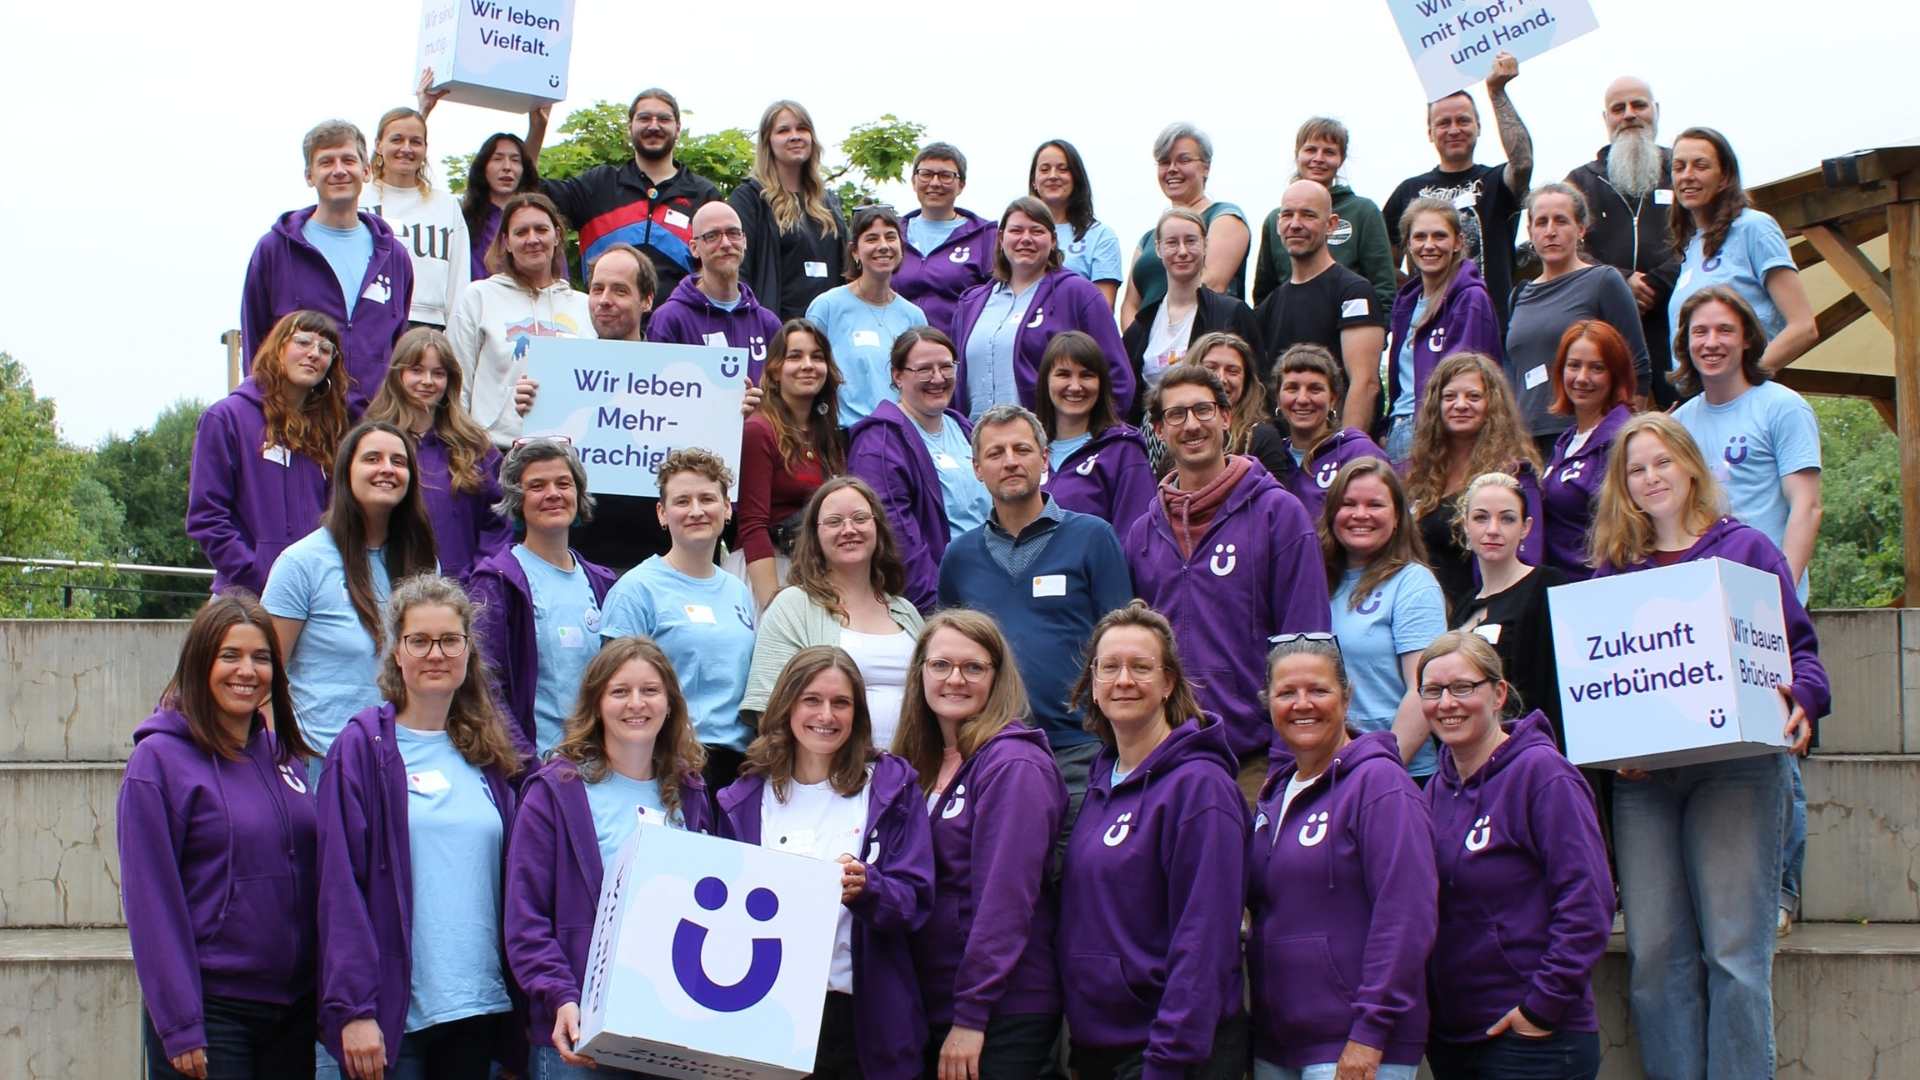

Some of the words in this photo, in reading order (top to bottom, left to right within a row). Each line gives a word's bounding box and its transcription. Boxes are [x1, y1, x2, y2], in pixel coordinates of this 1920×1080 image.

[471, 0, 503, 20] Wir
[508, 6, 560, 32] leben
[1420, 23, 1456, 48] mit
[1457, 0, 1513, 31] Kopf,
[480, 27, 549, 57] Vielfalt.
[1450, 34, 1491, 65] und
[1492, 8, 1556, 46] Hand.
[574, 368, 620, 393] Wir
[627, 371, 702, 398] leben
[597, 406, 678, 432] Mehr-
[1587, 622, 1695, 661] Zukunft
[1729, 616, 1748, 644] Wir
[1749, 622, 1785, 653] bauen
[1569, 660, 1723, 703] verbündet.
